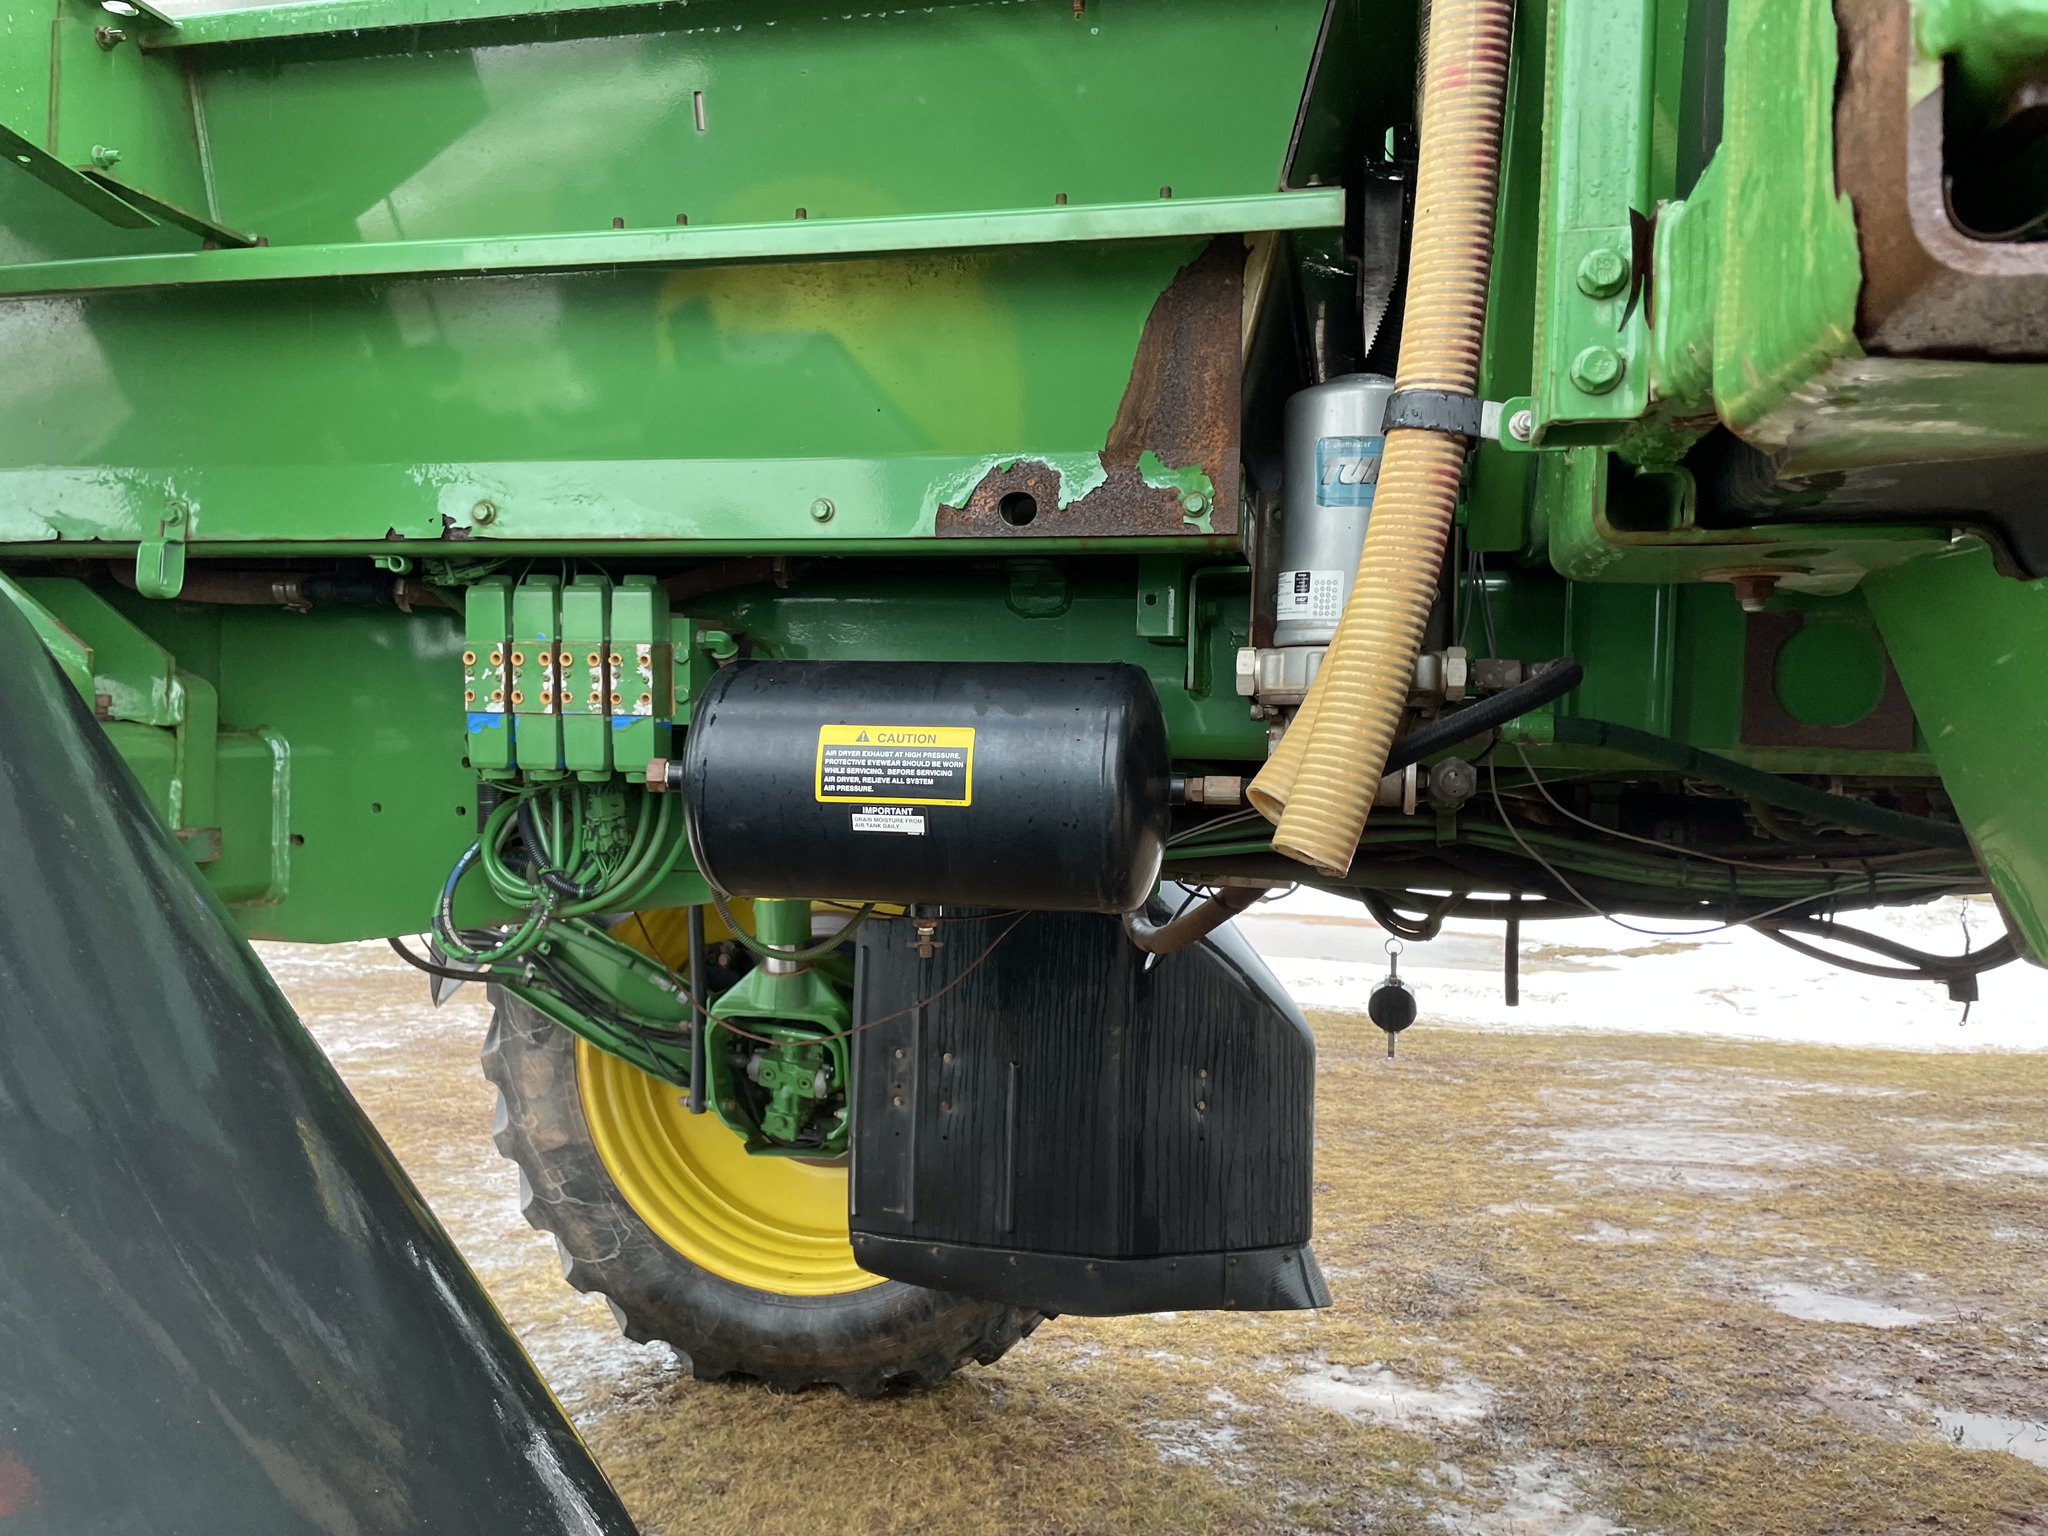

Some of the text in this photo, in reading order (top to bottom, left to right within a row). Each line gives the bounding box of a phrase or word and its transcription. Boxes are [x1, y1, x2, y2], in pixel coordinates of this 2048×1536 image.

[877, 733, 937, 744] CAUTION
[825, 749, 837, 757] AIR
[824, 758, 866, 766] PROTECTIVE
[846, 767, 884, 775] SERVICING.
[836, 776, 861, 784] DRYER,
[862, 776, 891, 784] RELIEVE
[905, 777, 934, 785] SYSTEM
[862, 806, 914, 816] IMPORTANT
